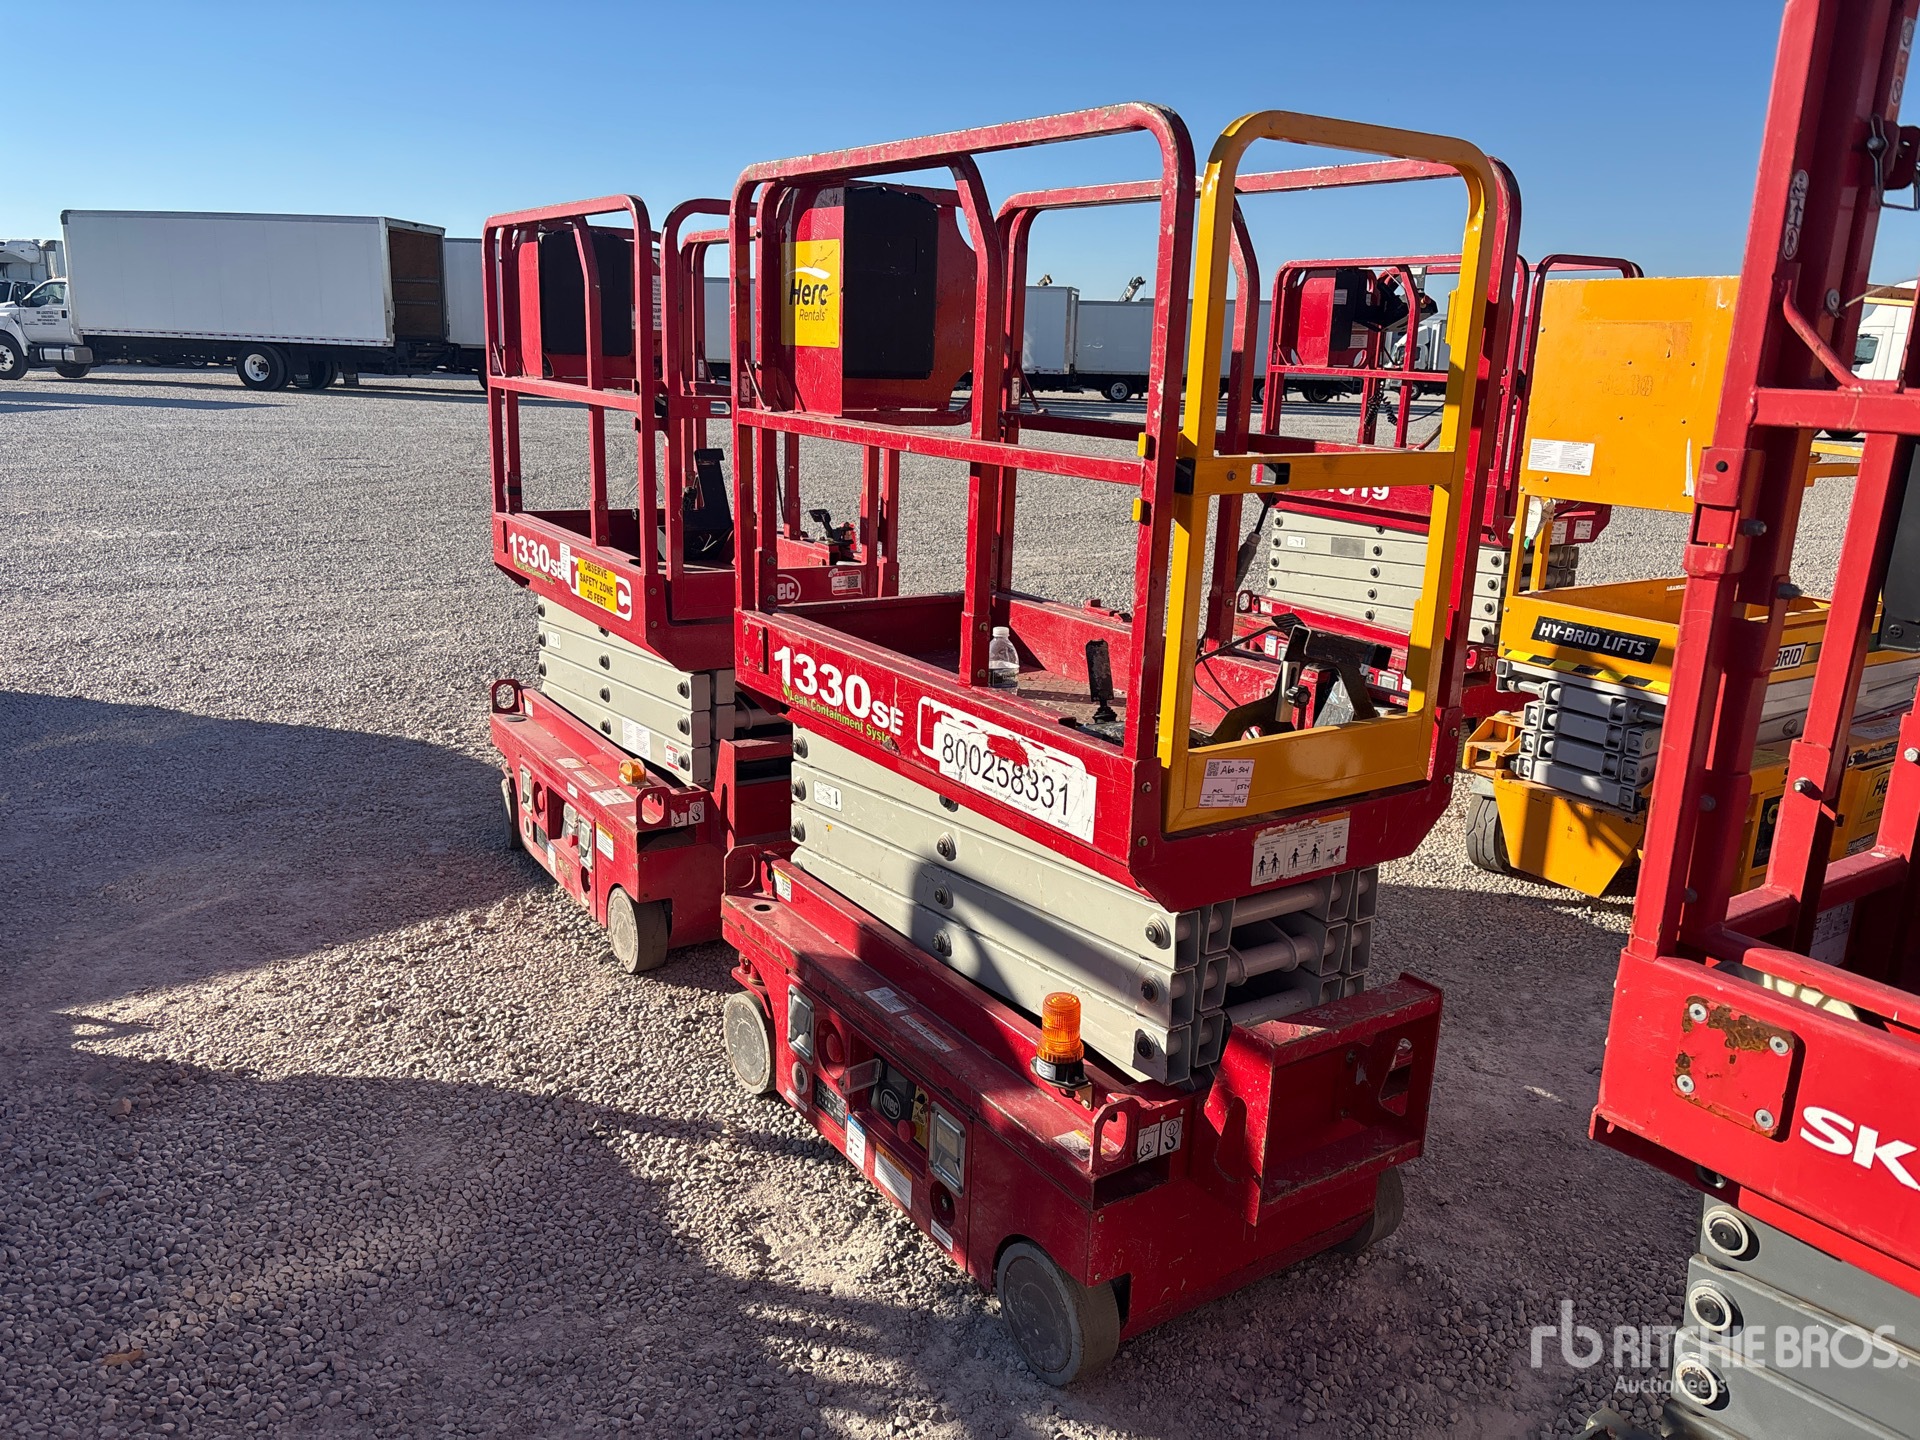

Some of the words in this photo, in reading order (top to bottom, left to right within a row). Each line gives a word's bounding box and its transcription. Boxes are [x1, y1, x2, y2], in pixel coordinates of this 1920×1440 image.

[789, 278, 829, 306] Herc
[799, 308, 826, 321] Rentals
[583, 561, 608, 580] OBSERVE
[579, 572, 599, 590] SAFETY
[599, 581, 614, 597] ZONE
[586, 588, 594, 600] 25
[593, 591, 607, 607] FEET
[1539, 622, 1600, 648] HY-BRID
[1602, 634, 1647, 657] LIFTS
[788, 689, 810, 706] Leak
[810, 698, 864, 734] Containment
[942, 732, 1069, 816] 800258331
